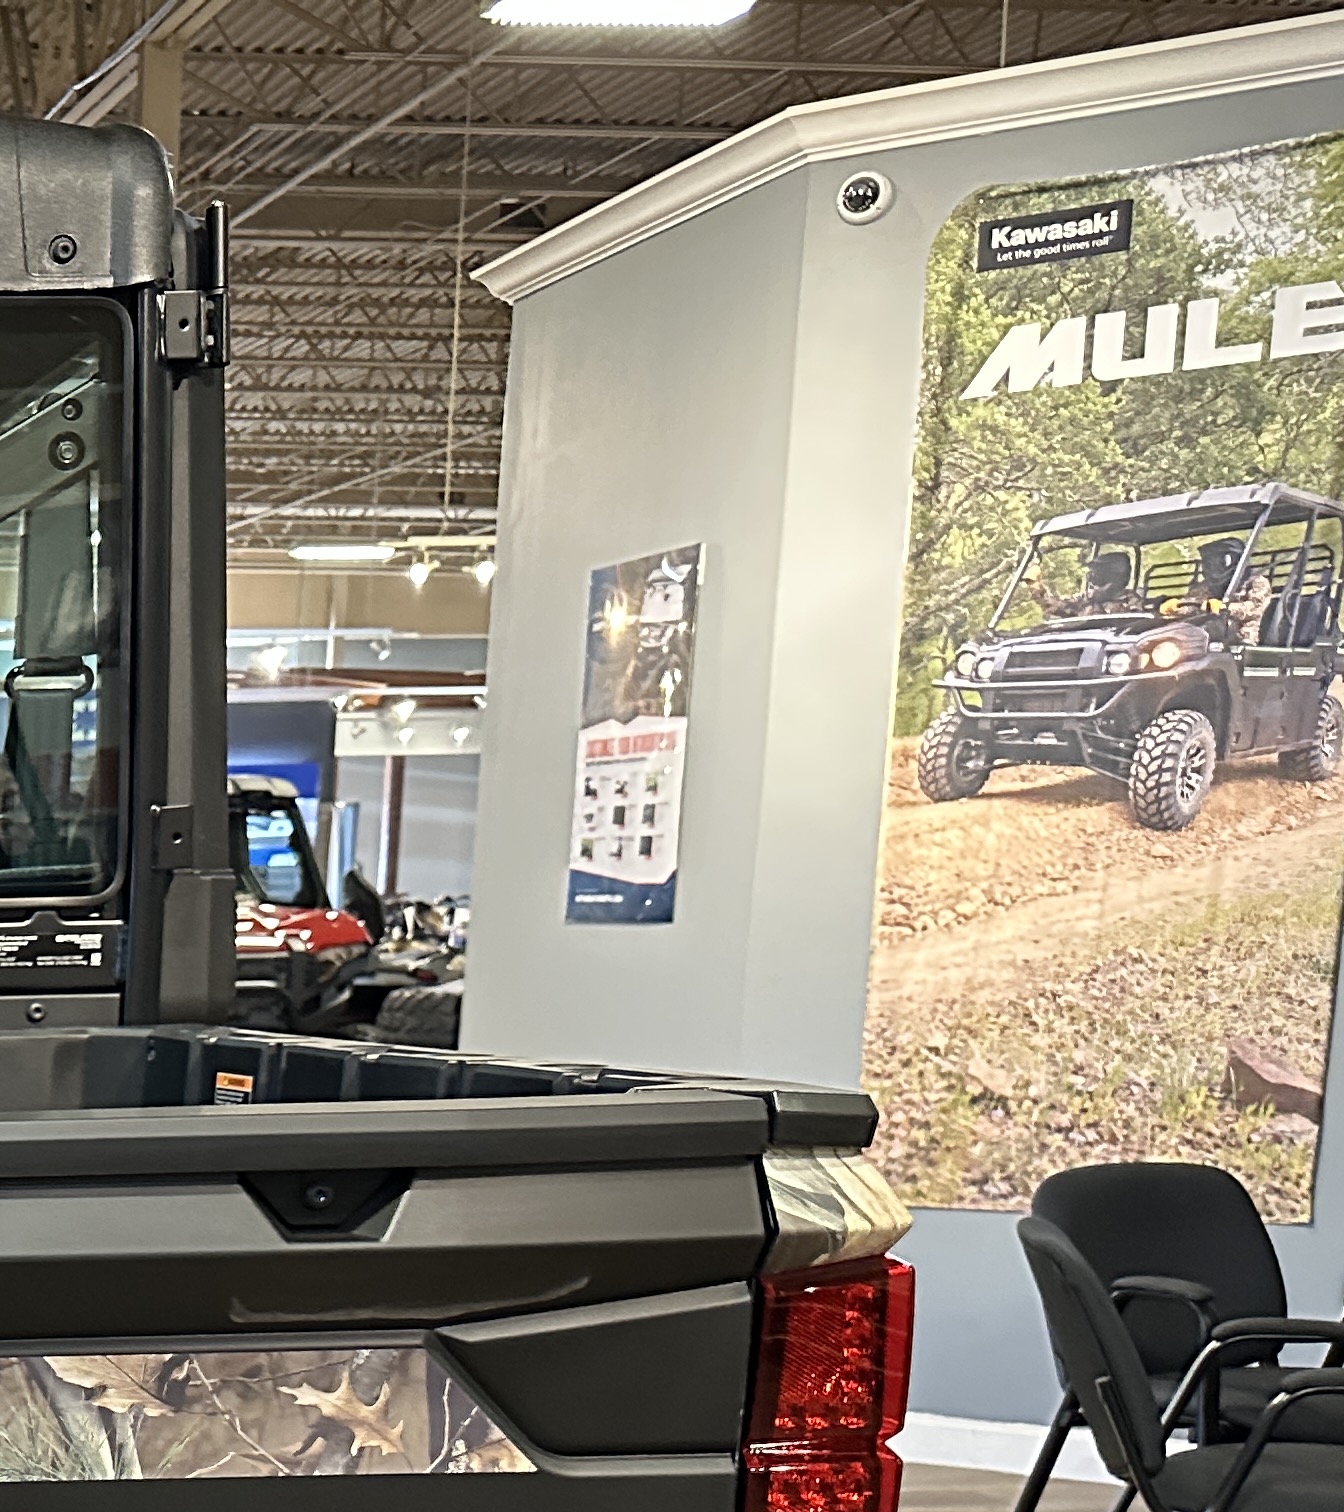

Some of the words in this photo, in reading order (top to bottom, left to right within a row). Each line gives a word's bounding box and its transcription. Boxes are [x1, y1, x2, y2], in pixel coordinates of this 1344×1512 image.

[991, 210, 1119, 249] Kawasaki
[997, 252, 1013, 262] Let
[1015, 248, 1031, 260] the
[1033, 243, 1060, 259] good
[1062, 240, 1090, 253] times
[1092, 236, 1109, 247] roll
[959, 280, 1344, 400] MULE
